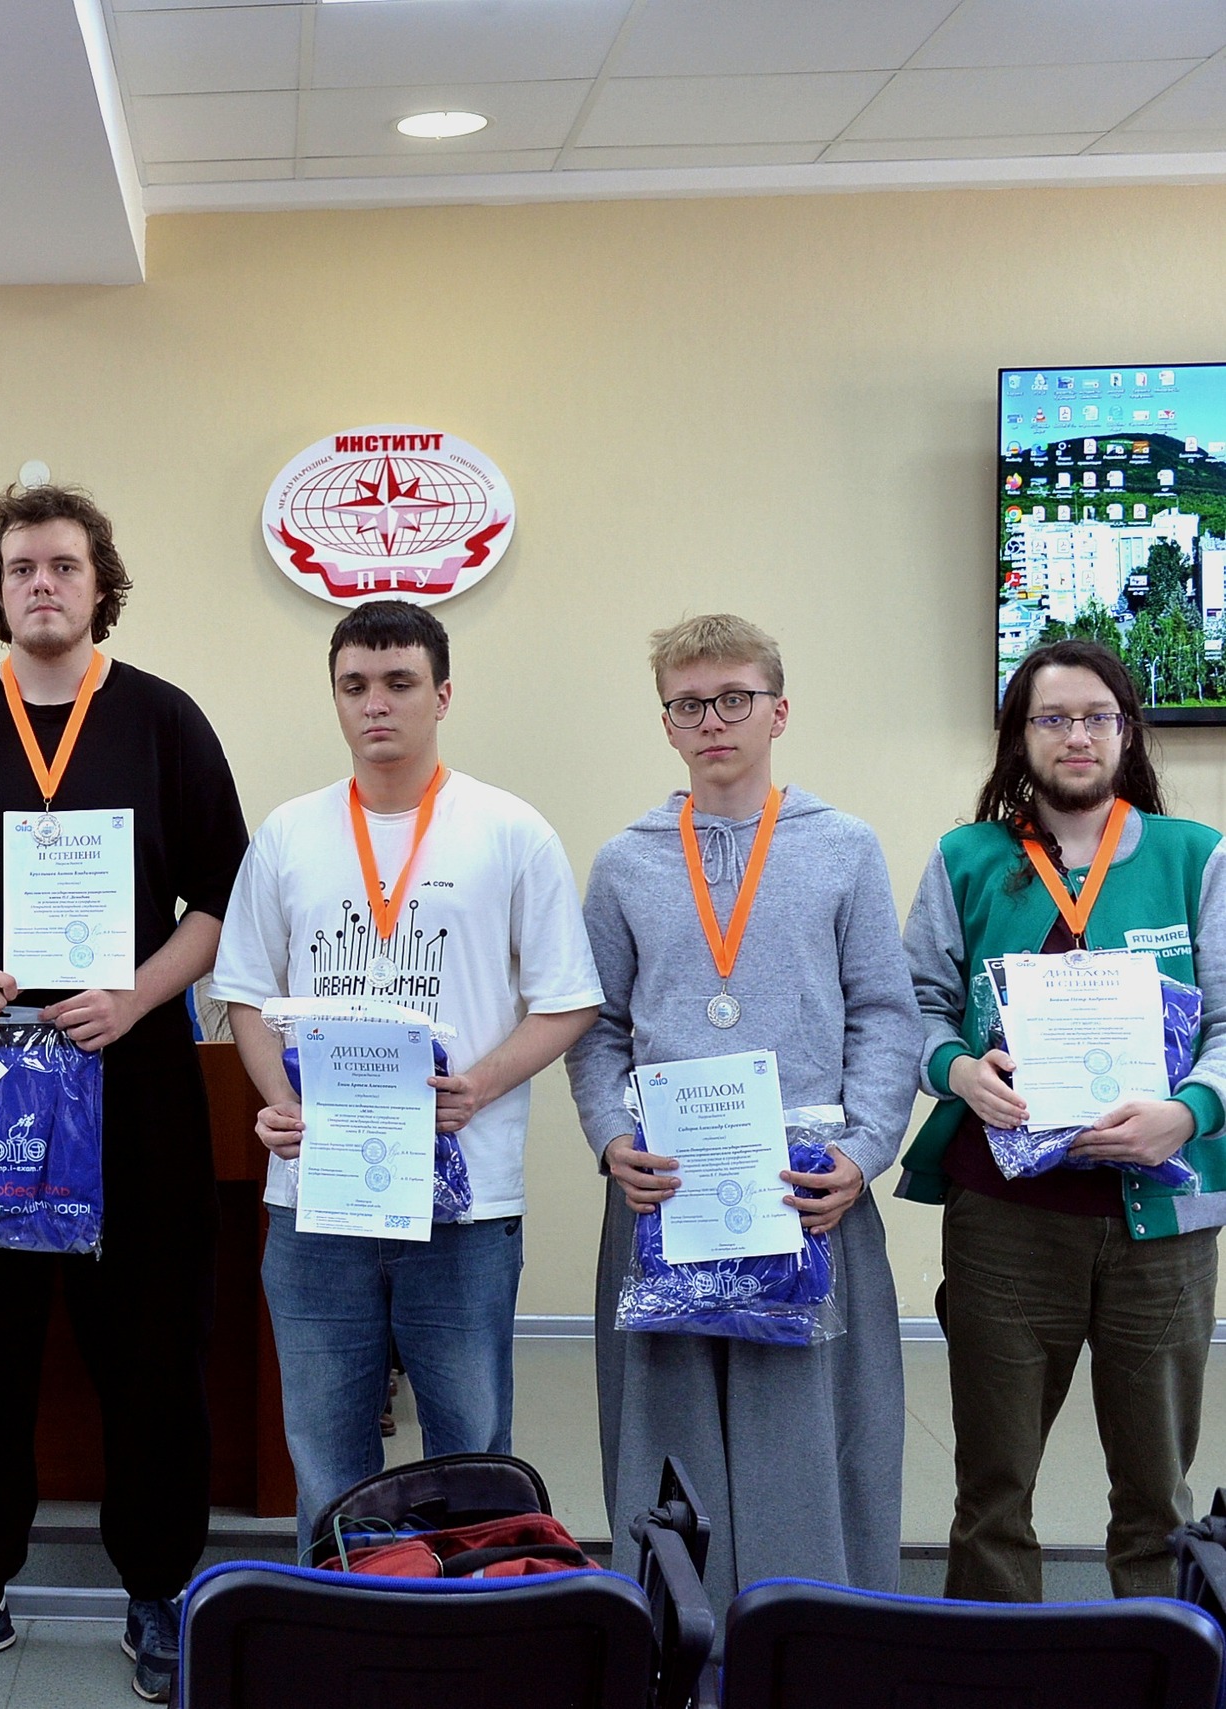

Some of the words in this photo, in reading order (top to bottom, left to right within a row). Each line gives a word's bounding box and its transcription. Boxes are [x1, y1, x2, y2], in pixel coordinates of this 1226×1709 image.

[335, 434, 444, 453] ИНСТИТУТ
[449, 453, 495, 491] ОТНОШЕНИЙ
[278, 455, 334, 511] МЕЖДУНАРОДНЫХ
[49, 851, 101, 860] СТЕПЕНИ
[1132, 934, 1152, 943] RTU
[1042, 969, 1119, 979] ДИПЛОМ
[313, 976, 366, 997] URBAN
[330, 1046, 399, 1060] ДИПЛОМ
[345, 1062, 399, 1072] СТЕПЕНИ
[675, 1083, 745, 1103] ДИПЛОМ
[690, 1100, 745, 1114] СТЕПЕНИ
